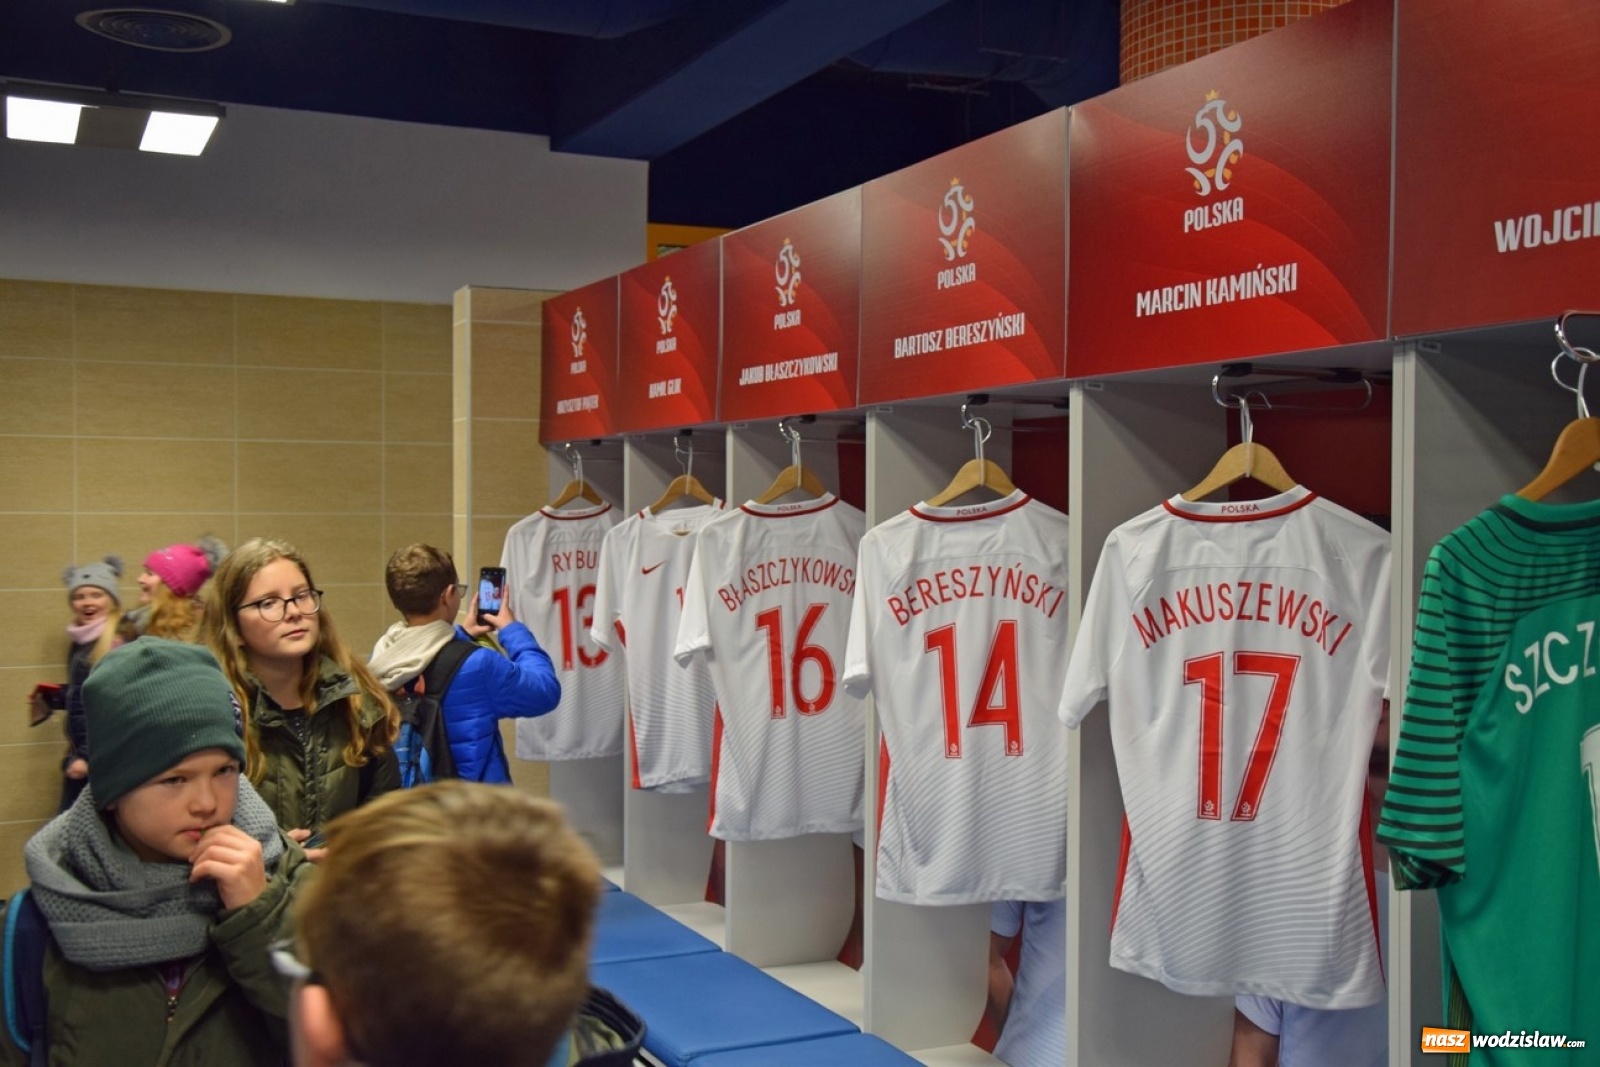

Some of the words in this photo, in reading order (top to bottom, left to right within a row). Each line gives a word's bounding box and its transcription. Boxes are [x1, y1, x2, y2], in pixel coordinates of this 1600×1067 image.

[1184, 197, 1244, 233] POLSKA
[937, 262, 976, 290] POLSKA
[1136, 282, 1202, 318] MARCIN
[1206, 263, 1298, 304] KAMIŃSKI
[774, 310, 801, 330] POLSKA
[894, 330, 943, 359] BARTOSZ
[945, 312, 1025, 350] BERESZYŃSKI
[765, 352, 838, 382] BŁASZCZYKOWSKI
[956, 506, 988, 516] POLSKA
[1221, 503, 1260, 514] POLSKA
[552, 550, 599, 573] RYBU
[887, 562, 1065, 626] BERESZYŃSKI
[1132, 582, 1353, 656] MAKUSZEWSKI
[755, 602, 836, 720] 16
[1505, 621, 1600, 714] SZCZ
[924, 619, 1023, 758] 14
[1183, 651, 1301, 821] 17
